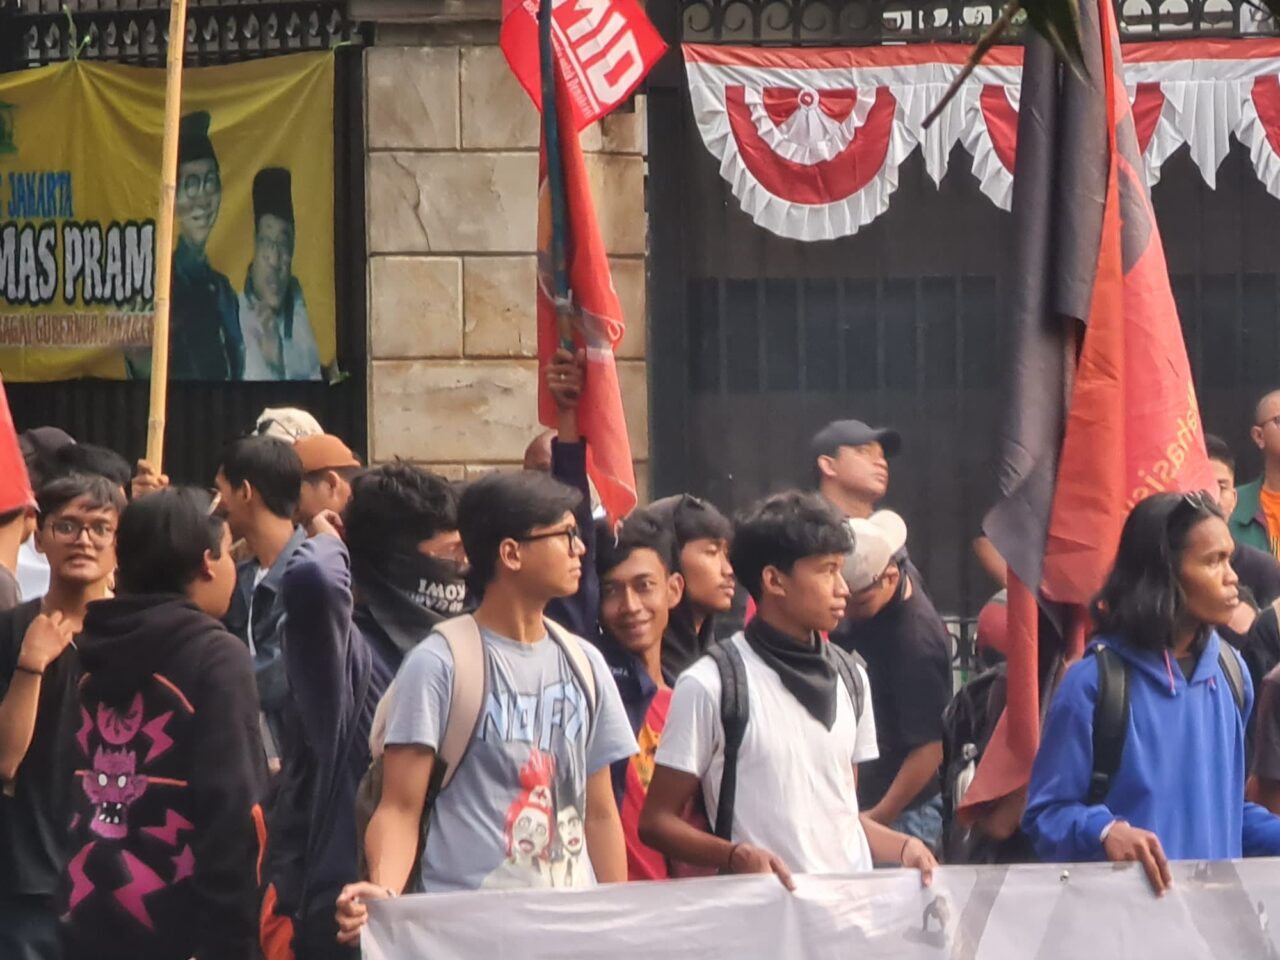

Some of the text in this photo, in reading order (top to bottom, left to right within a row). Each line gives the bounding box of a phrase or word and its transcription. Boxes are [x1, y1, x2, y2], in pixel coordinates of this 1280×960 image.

[8, 171, 74, 218] JAKARTA
[63, 219, 156, 306] PRAM
[476, 677, 584, 752] NOFX
